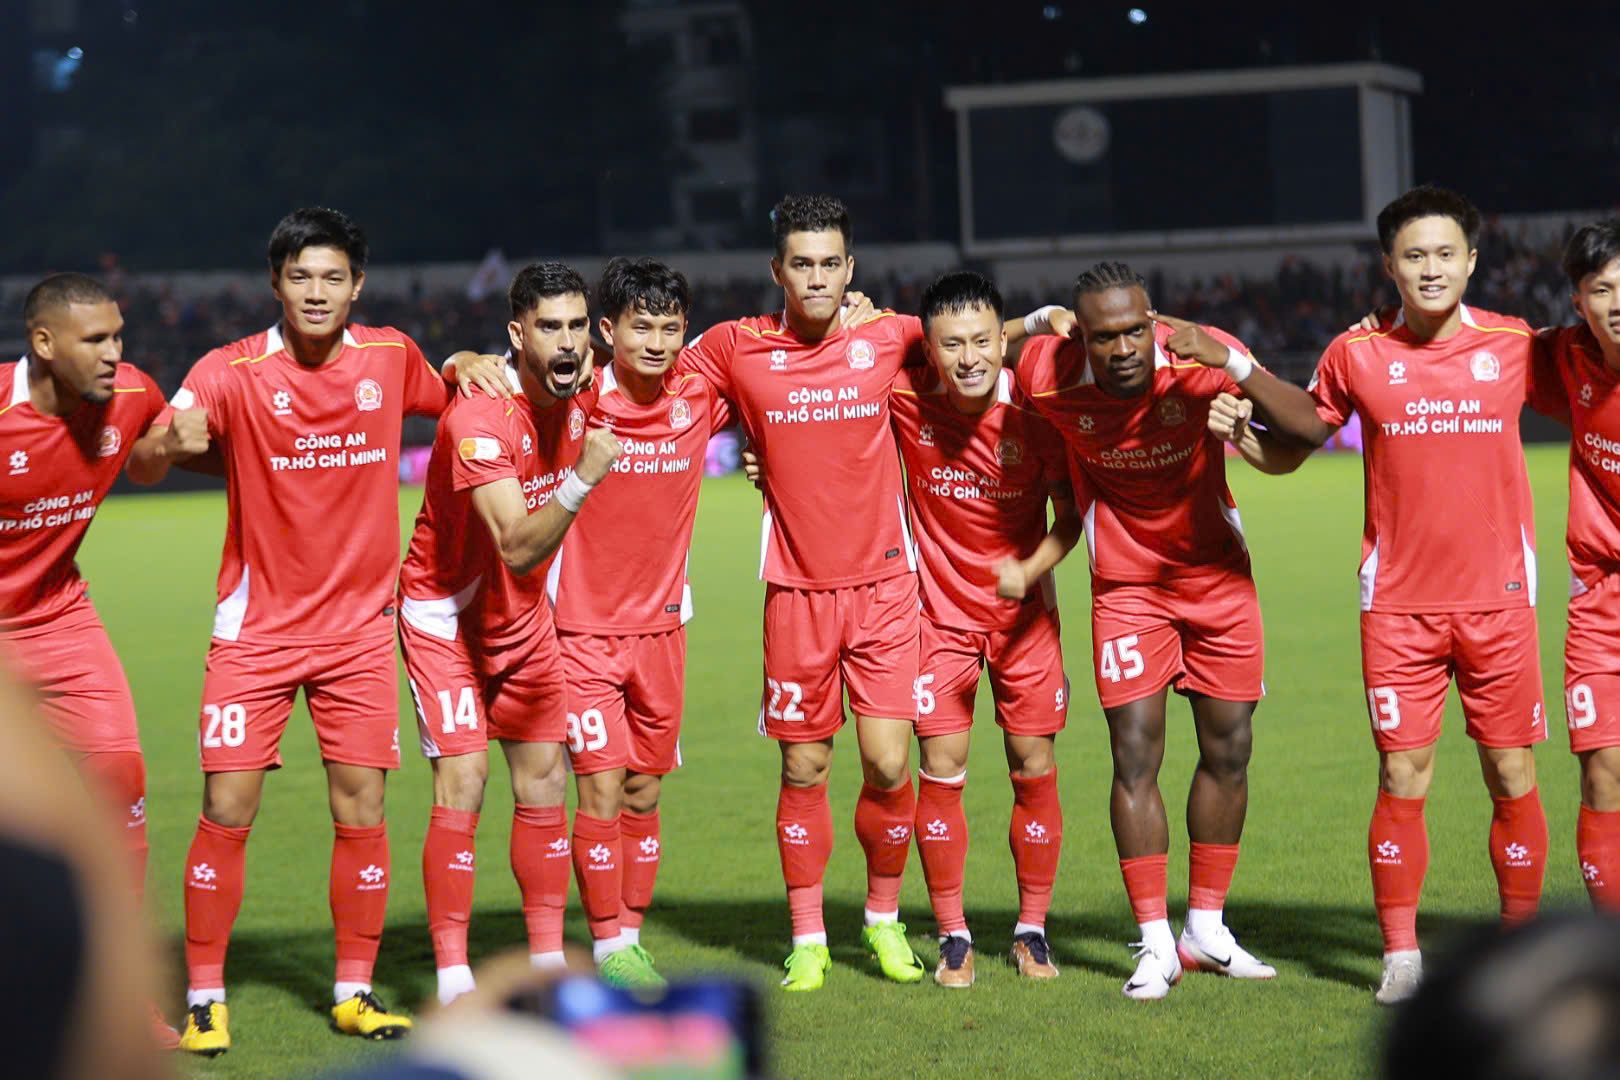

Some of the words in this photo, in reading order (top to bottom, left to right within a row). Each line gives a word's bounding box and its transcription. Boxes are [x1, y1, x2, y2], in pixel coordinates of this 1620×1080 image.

[788, 387, 834, 404] CÔNG
[838, 386, 858, 400] AN
[813, 403, 839, 421] CHÍ
[843, 402, 880, 419] MINH
[1405, 397, 1454, 415] CÔNG
[1458, 400, 1480, 413] AN
[1431, 416, 1460, 433] CHÍ
[1463, 419, 1503, 433] MINH
[295, 433, 342, 450] CÔNG
[345, 432, 366, 447] AN
[659, 441, 676, 454] AN
[1151, 442, 1172, 456] AN
[318, 450, 347, 467] CHÍ
[350, 448, 386, 465] MINH
[634, 457, 659, 473] CHÍ
[662, 457, 690, 473] MINH
[523, 475, 555, 493] CÔNG
[931, 466, 976, 482] CÔNG
[979, 475, 1000, 488] AN
[24, 497, 70, 513] CÔNG
[72, 490, 93, 505] AN
[45, 508, 73, 527] CHÍ
[1100, 634, 1145, 683] 45
[768, 677, 805, 722] 22
[437, 686, 478, 734] 14
[203, 703, 247, 748] 28
